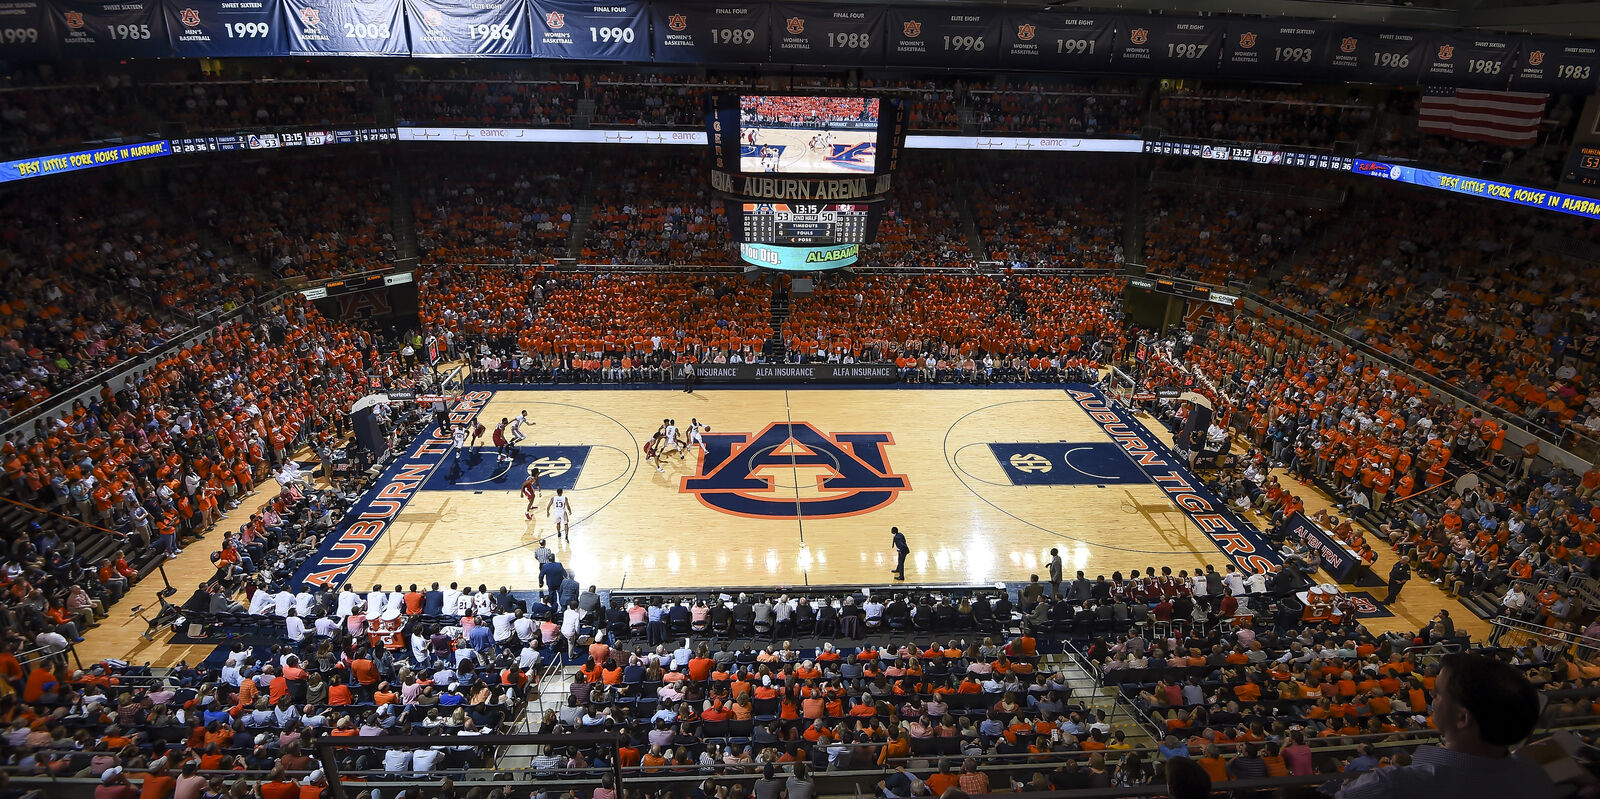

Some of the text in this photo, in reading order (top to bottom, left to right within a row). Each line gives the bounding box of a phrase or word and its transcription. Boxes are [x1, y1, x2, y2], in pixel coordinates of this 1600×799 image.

[108, 24, 151, 40] 1985
[224, 22, 269, 38] 1999
[344, 23, 391, 38] 2003
[468, 24, 514, 40] 1986
[590, 26, 635, 44] 1990
[712, 28, 755, 44] 1989
[828, 32, 870, 48] 1988
[943, 36, 984, 52] 1996
[1056, 39, 1096, 55] 1991
[1168, 43, 1208, 60] 1987
[1274, 47, 1312, 63] 1993
[1372, 52, 1410, 68] 1986
[1467, 58, 1502, 76] 1985
[1556, 64, 1592, 80] 1983
[282, 133, 303, 142] 13:15
[310, 136, 321, 144] 50
[712, 96, 724, 168] TIGERS
[890, 98, 904, 170] AUBURN
[43, 157, 68, 172] LITTLE
[70, 154, 92, 167] PORK
[94, 151, 118, 163] HOUSE
[120, 148, 129, 159] IN
[1232, 148, 1252, 156] 13:15
[1331, 161, 1340, 169] 18
[1342, 162, 1352, 170] 36
[1586, 156, 1600, 168] 53
[742, 176, 811, 200] AUBURN
[816, 178, 868, 200] ARENA
[1460, 178, 1486, 194] LITTLE
[1487, 184, 1512, 200] PORK
[1514, 188, 1545, 206] HOUSE
[1548, 195, 1560, 207] IN
[777, 212, 789, 221] 53
[795, 204, 818, 214] 13:15
[822, 213, 834, 222] 50
[745, 245, 781, 264] You Dig.
[1132, 280, 1152, 288] verizon
[678, 368, 736, 377] AA INSURANCE
[756, 368, 814, 376] ALFA INSURANCE
[832, 368, 890, 376] ALFA INSURANCE
[1066, 388, 1276, 576] AUBURN TIGERS
[302, 463, 434, 592] AUBURN
[459, 602, 468, 610] 21
[1313, 608, 1324, 617] G
[380, 636, 393, 645] G
